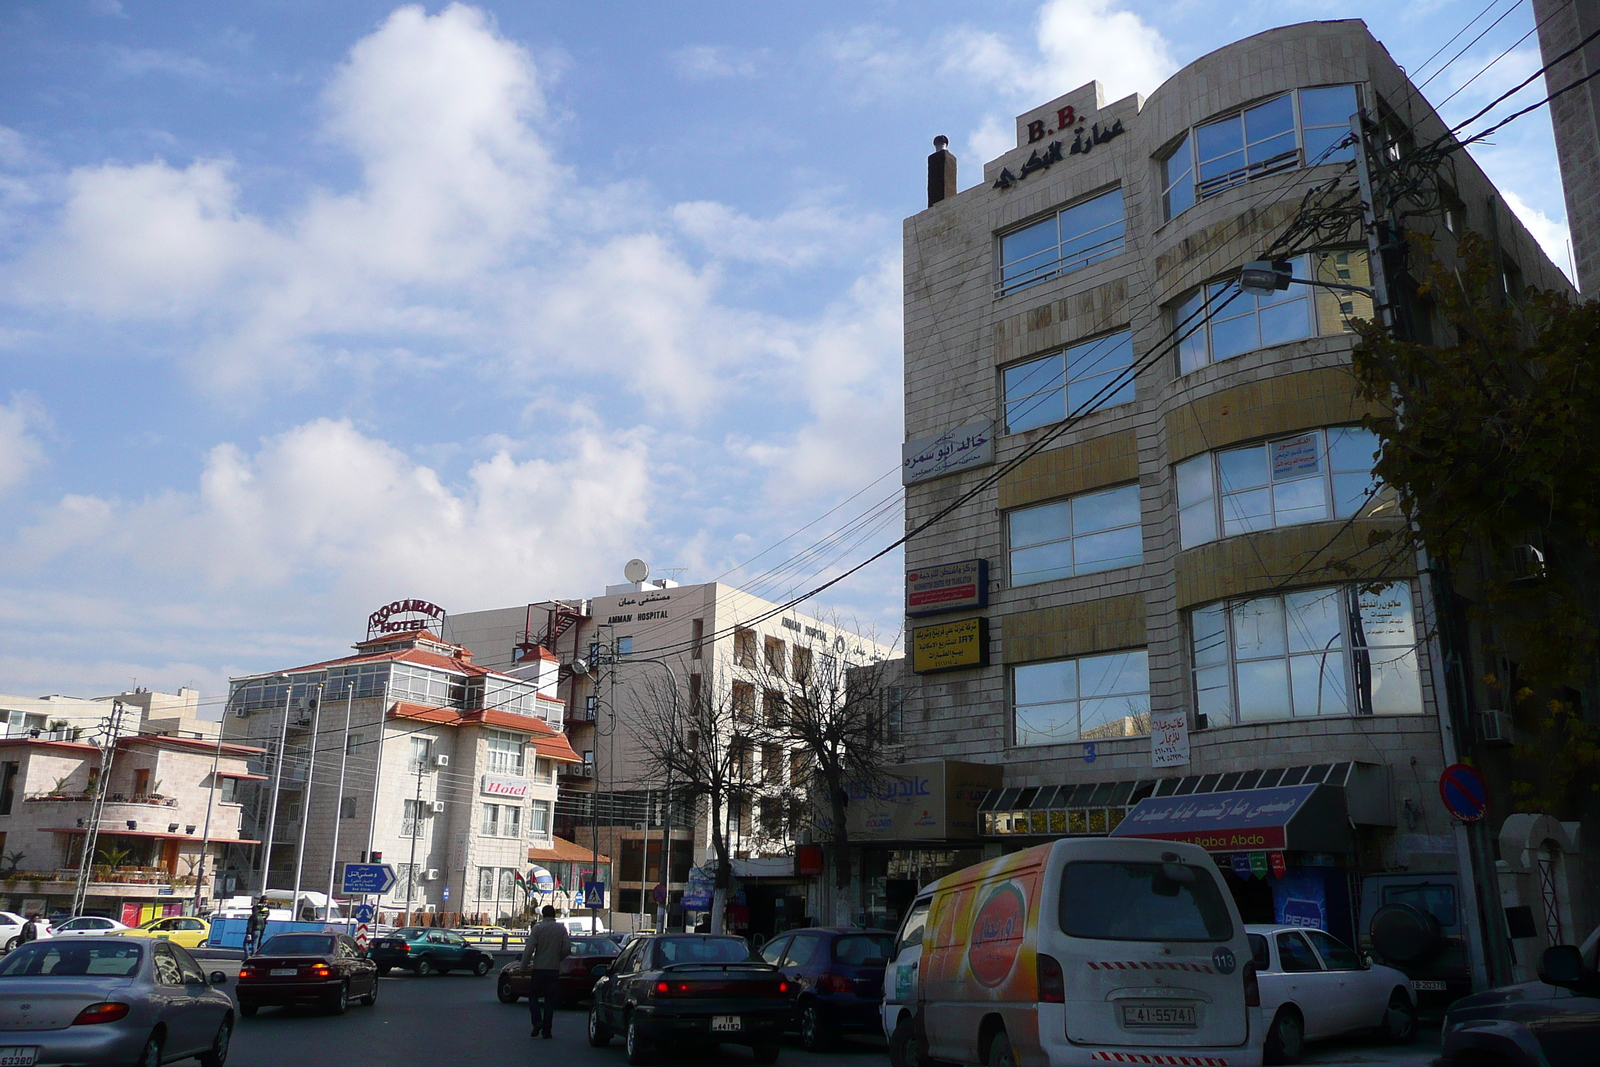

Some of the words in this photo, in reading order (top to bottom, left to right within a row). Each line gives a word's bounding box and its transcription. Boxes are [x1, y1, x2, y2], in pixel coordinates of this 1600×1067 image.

[1069, 118, 1125, 155] عمارة
[957, 434, 988, 452] خالد
[962, 563, 977, 575] مركز
[618, 597, 636, 607] عمان
[638, 592, 671, 606] مستشفى
[607, 614, 633, 624] AMMAN
[637, 610, 669, 621] HOSPITAL
[380, 619, 429, 633] HOTEL
[1082, 742, 1097, 764] 3
[487, 782, 527, 796] Hotel
[1196, 798, 1250, 821] ماركت
[1195, 836, 1227, 847] Baba
[1230, 834, 1265, 846] Abdo
[1284, 913, 1321, 929] PEPSI
[1214, 954, 1235, 968] 113
[1137, 1008, 1192, 1022] 41-55741
[14, 1048, 24, 1057] 11
[1, 1056, 33, 1067] 63380
